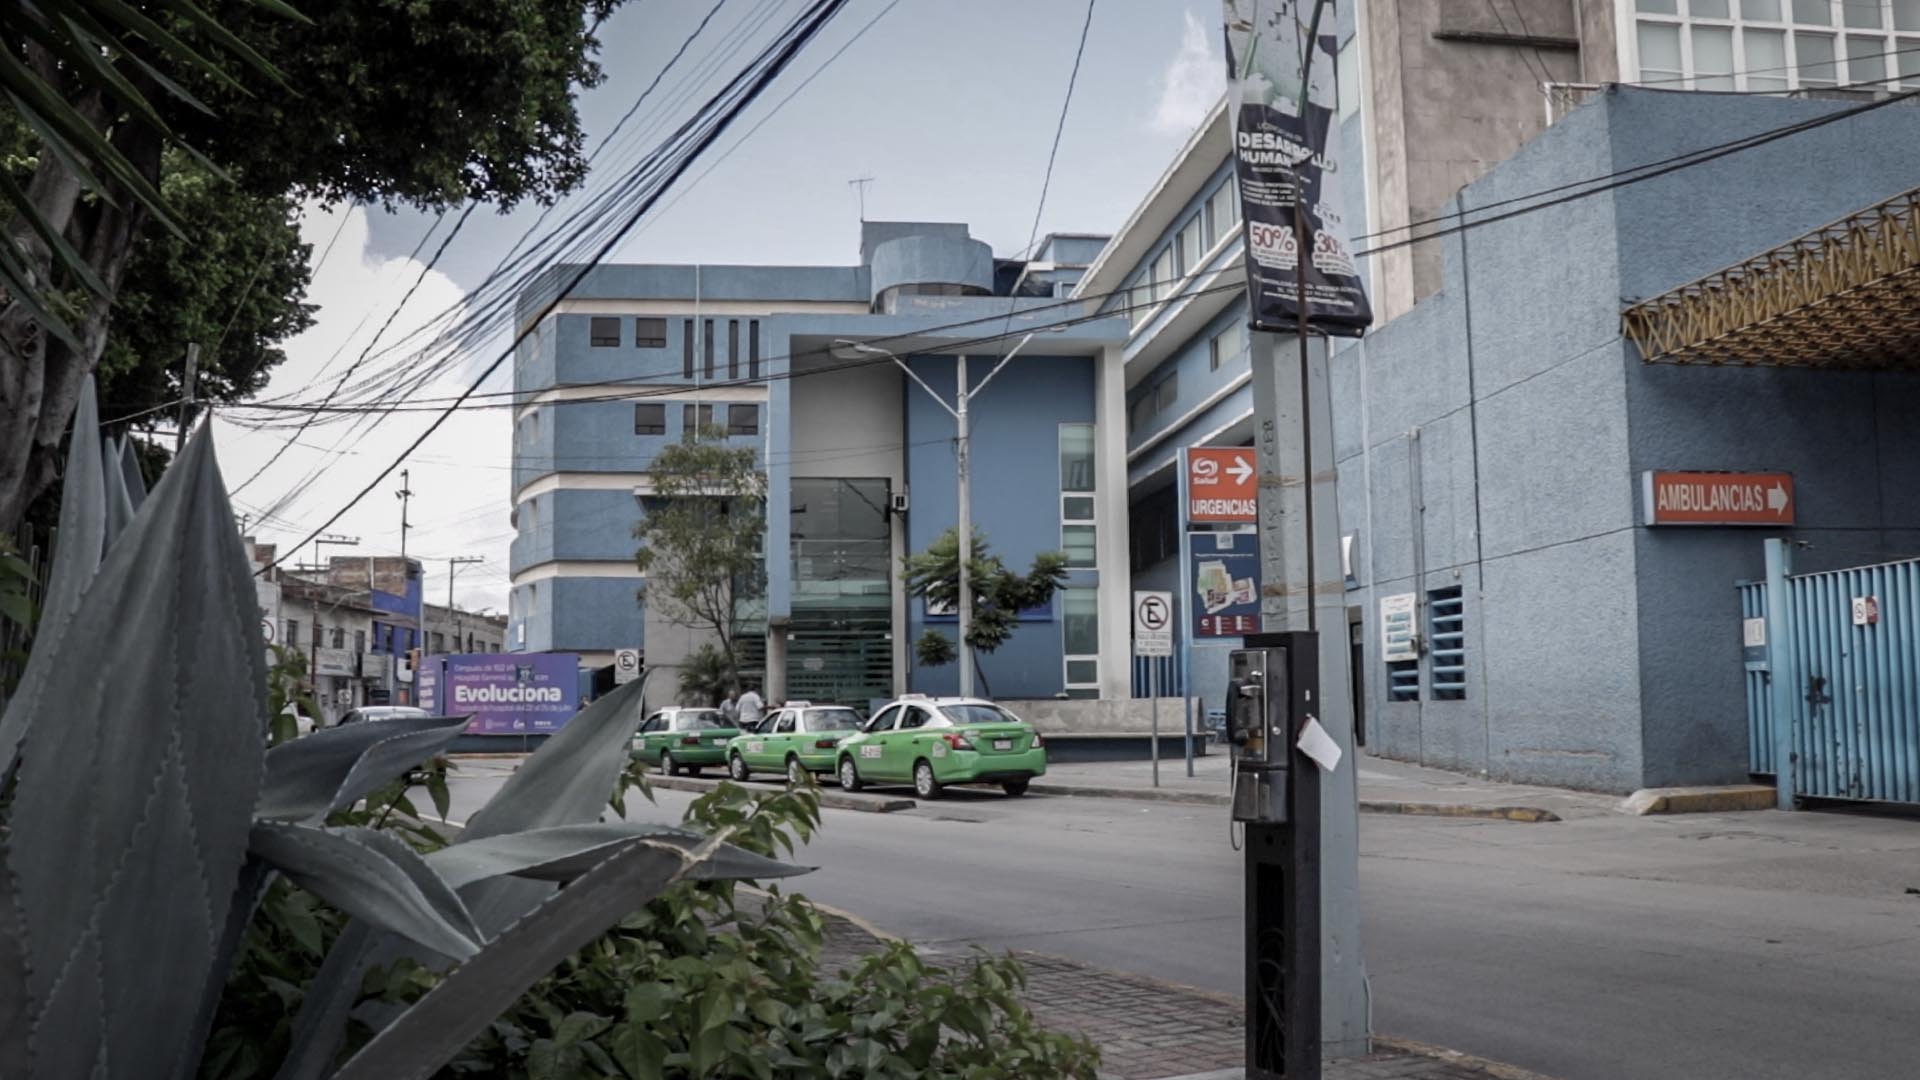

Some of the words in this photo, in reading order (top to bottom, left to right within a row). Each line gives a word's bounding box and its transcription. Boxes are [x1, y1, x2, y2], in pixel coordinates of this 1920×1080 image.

[1252, 225, 1295, 251] 50%
[1192, 499, 1257, 515] URGENCIAS
[1658, 483, 1764, 511] AMBULANCIAS
[455, 683, 561, 702] Evoluciona
